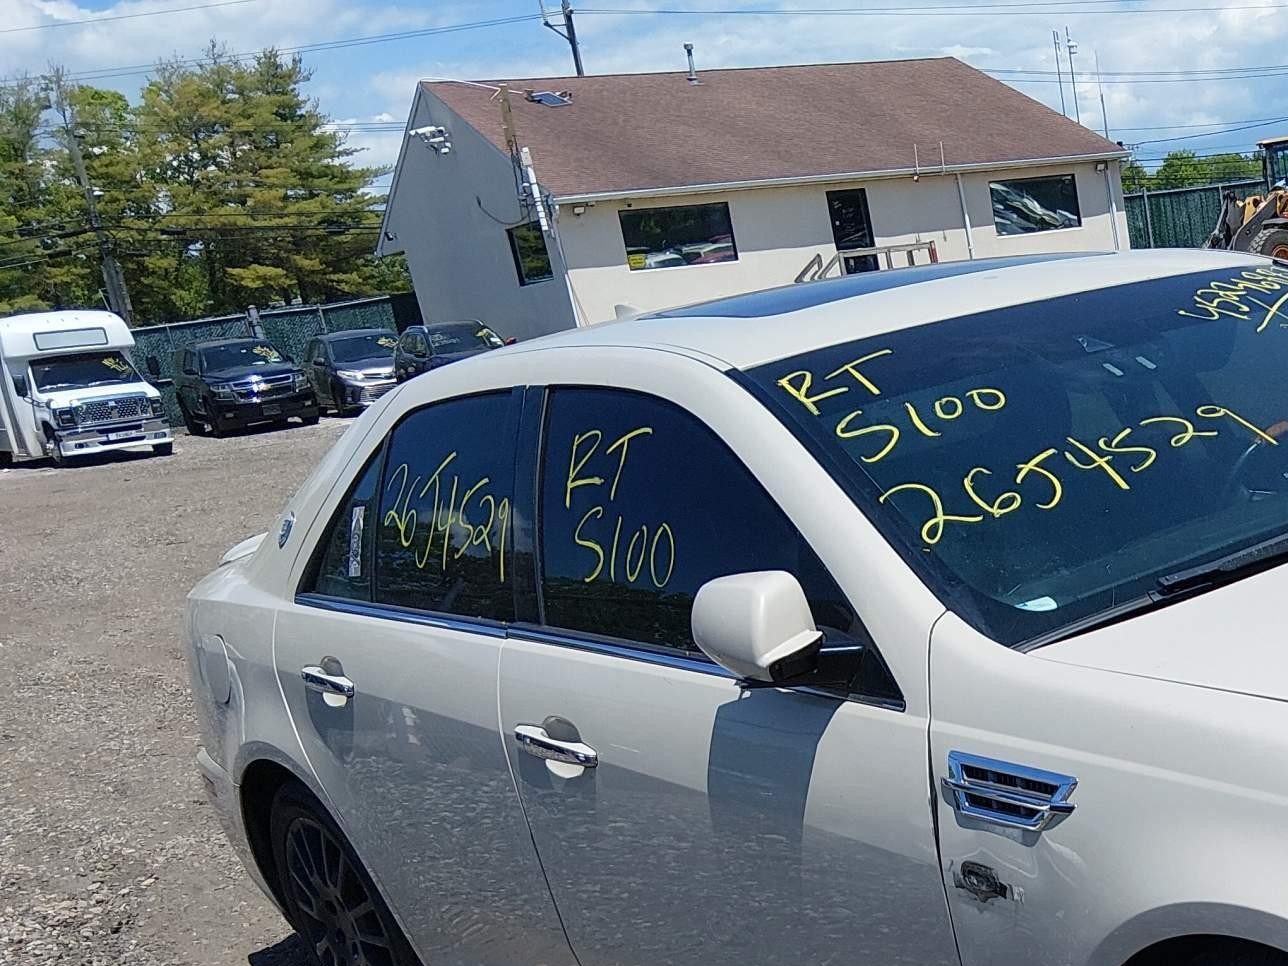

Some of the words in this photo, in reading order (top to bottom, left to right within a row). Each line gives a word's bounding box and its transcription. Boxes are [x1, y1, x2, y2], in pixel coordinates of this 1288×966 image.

[776, 349, 893, 416] RT
[384, 451, 510, 583] 26J4529
[565, 426, 653, 509] RT
[878, 404, 1279, 545] 26J4529
